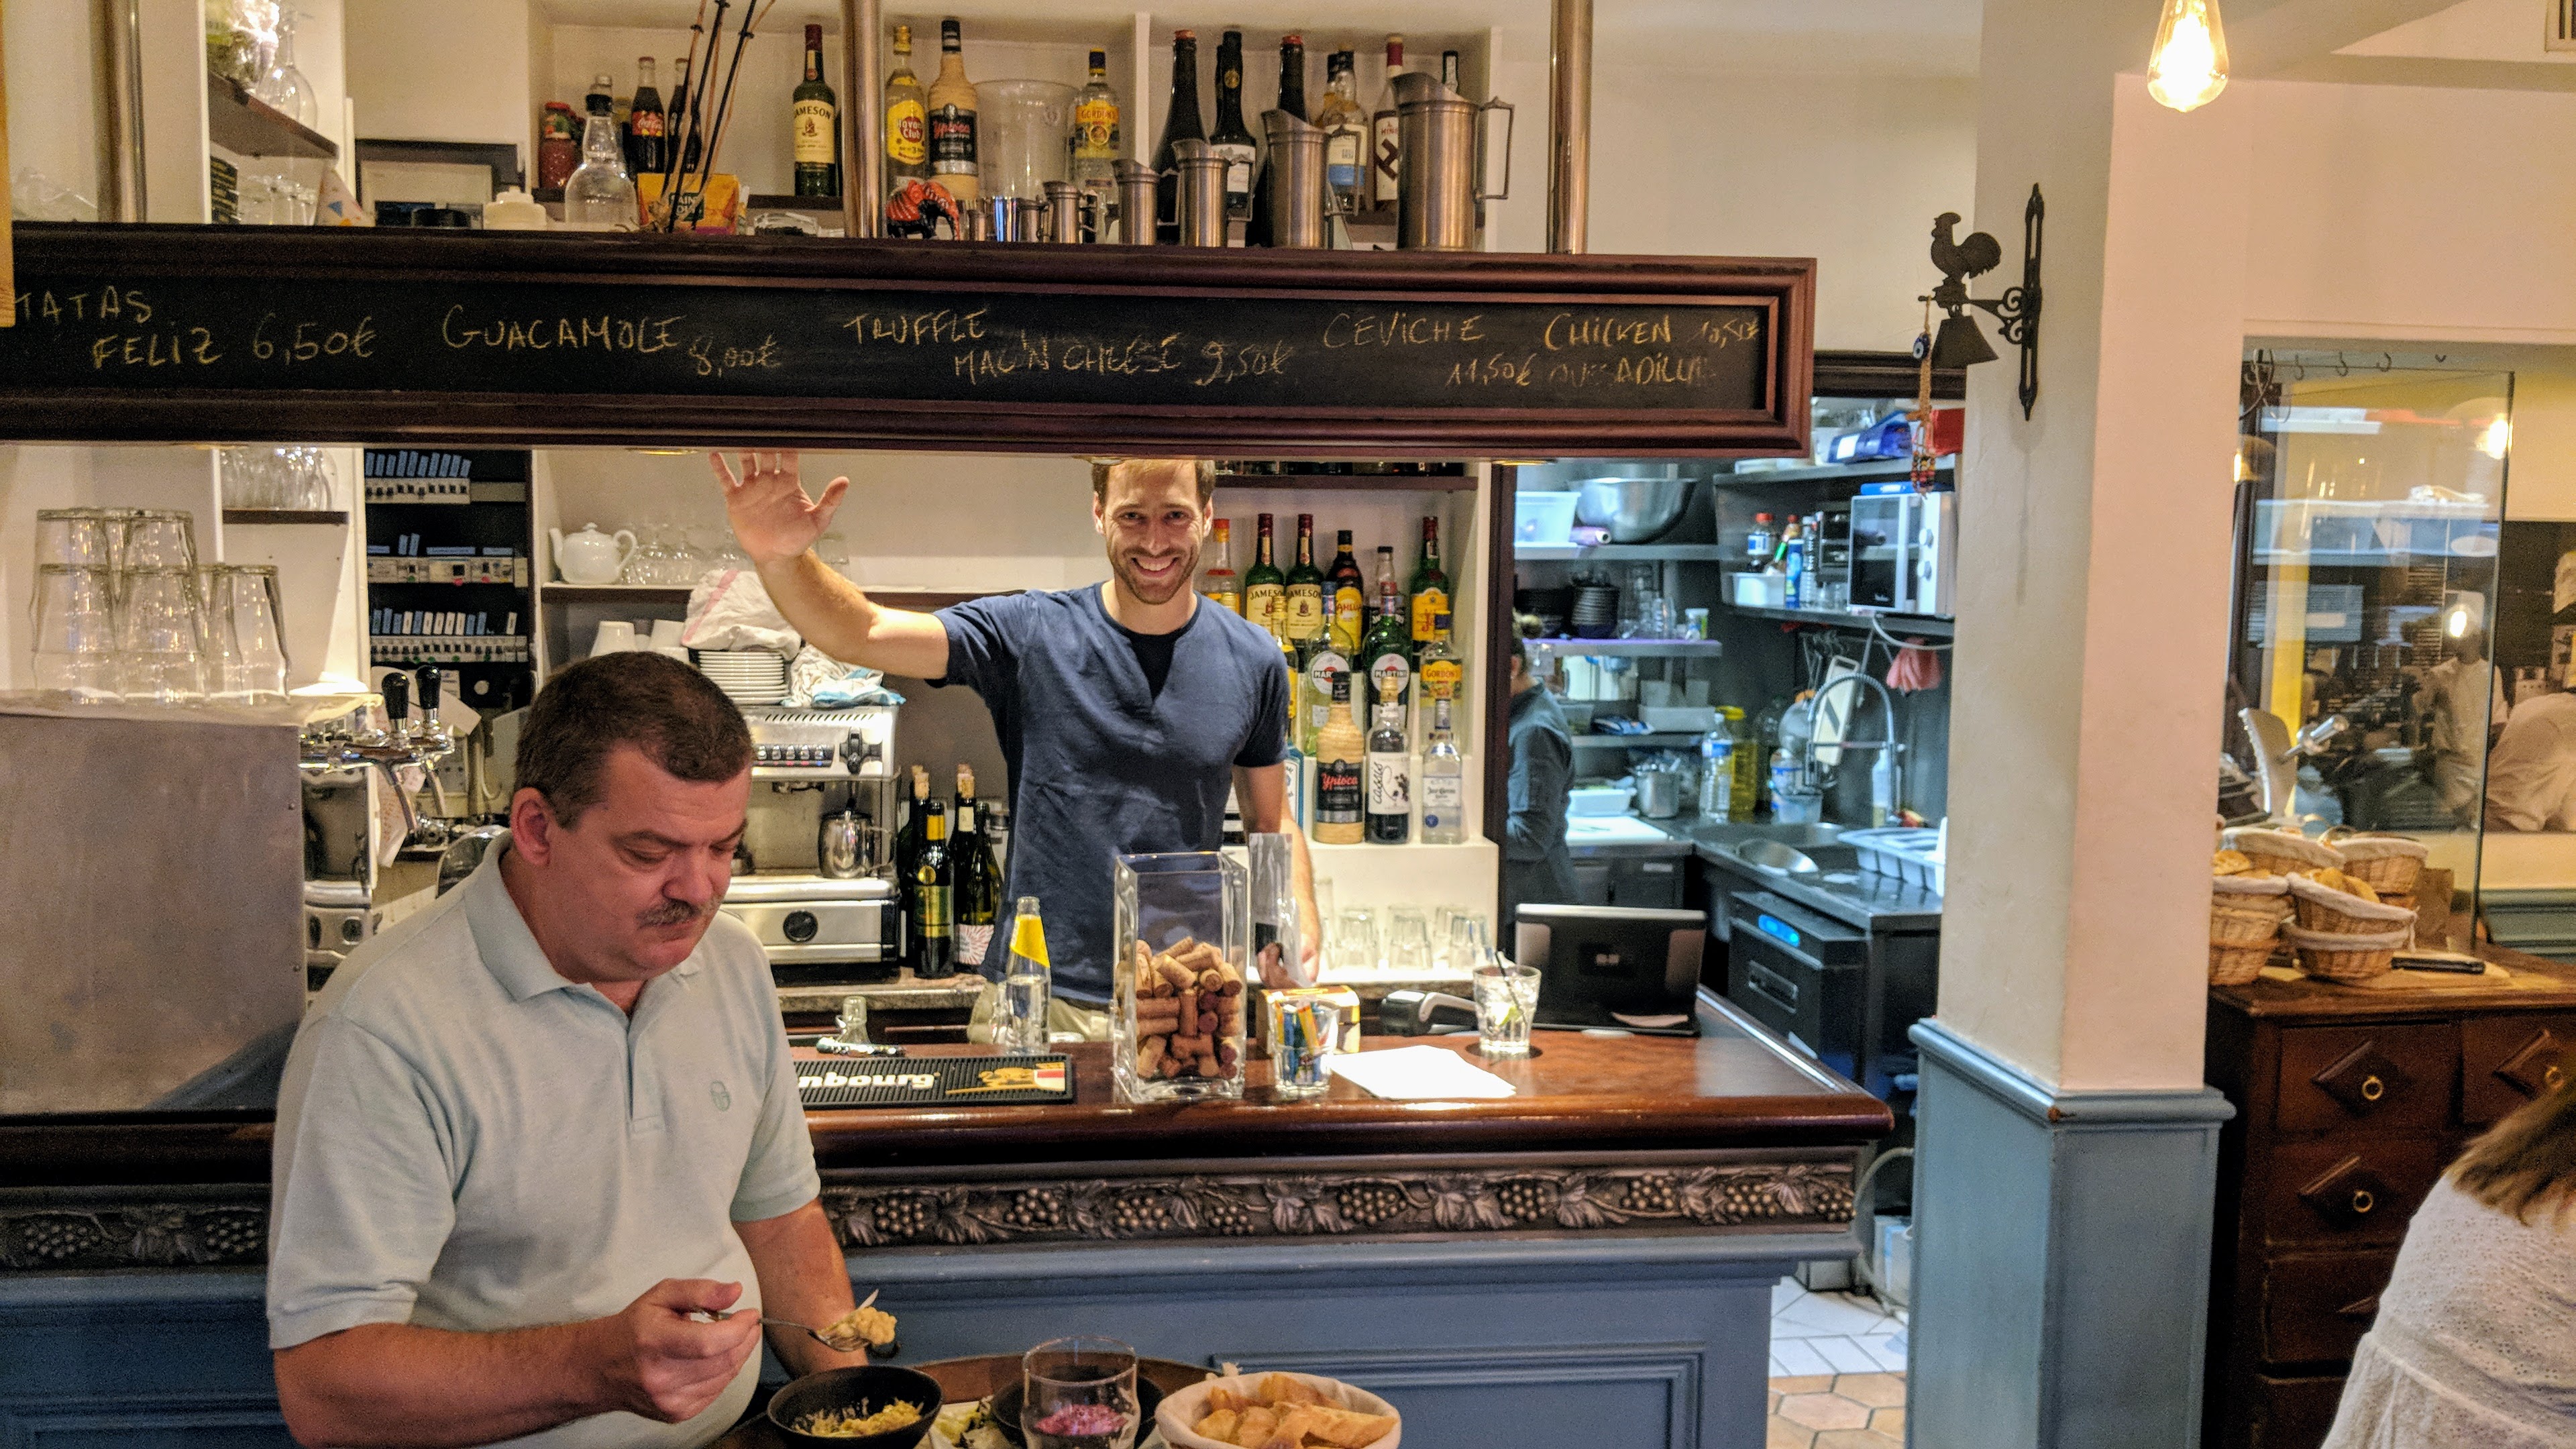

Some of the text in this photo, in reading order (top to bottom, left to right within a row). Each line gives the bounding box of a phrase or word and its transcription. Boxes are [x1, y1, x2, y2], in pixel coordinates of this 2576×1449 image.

[253, 313, 377, 366] 6,50€
[441, 304, 687, 353] GUACAMOLE
[843, 308, 989, 345] TRUFFLE
